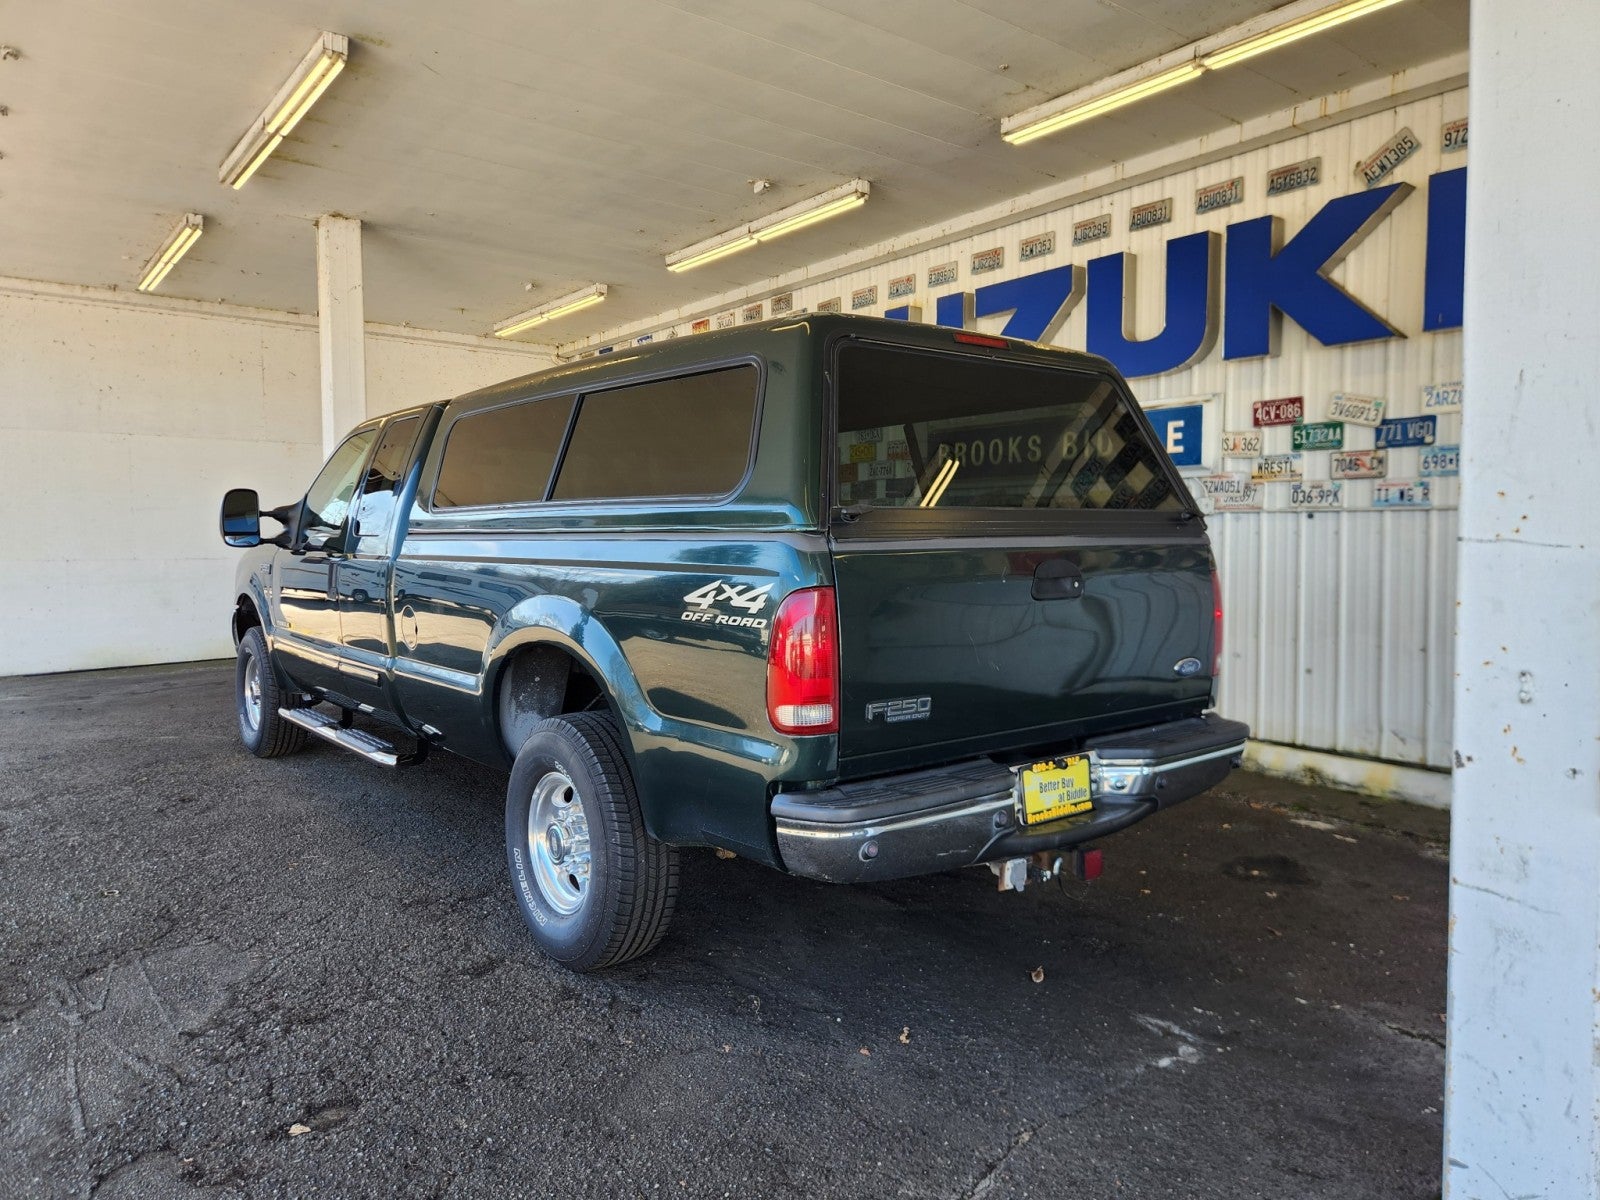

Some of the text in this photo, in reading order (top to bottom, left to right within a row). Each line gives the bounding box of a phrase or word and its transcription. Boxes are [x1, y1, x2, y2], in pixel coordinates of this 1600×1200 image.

[1363, 136, 1414, 184] AEW1385
[1255, 402, 1301, 421] 4CV-086
[1257, 459, 1297, 475] WRESTL
[681, 611, 768, 628] OFF ROAD
[1039, 777, 1075, 794] Better Buy
